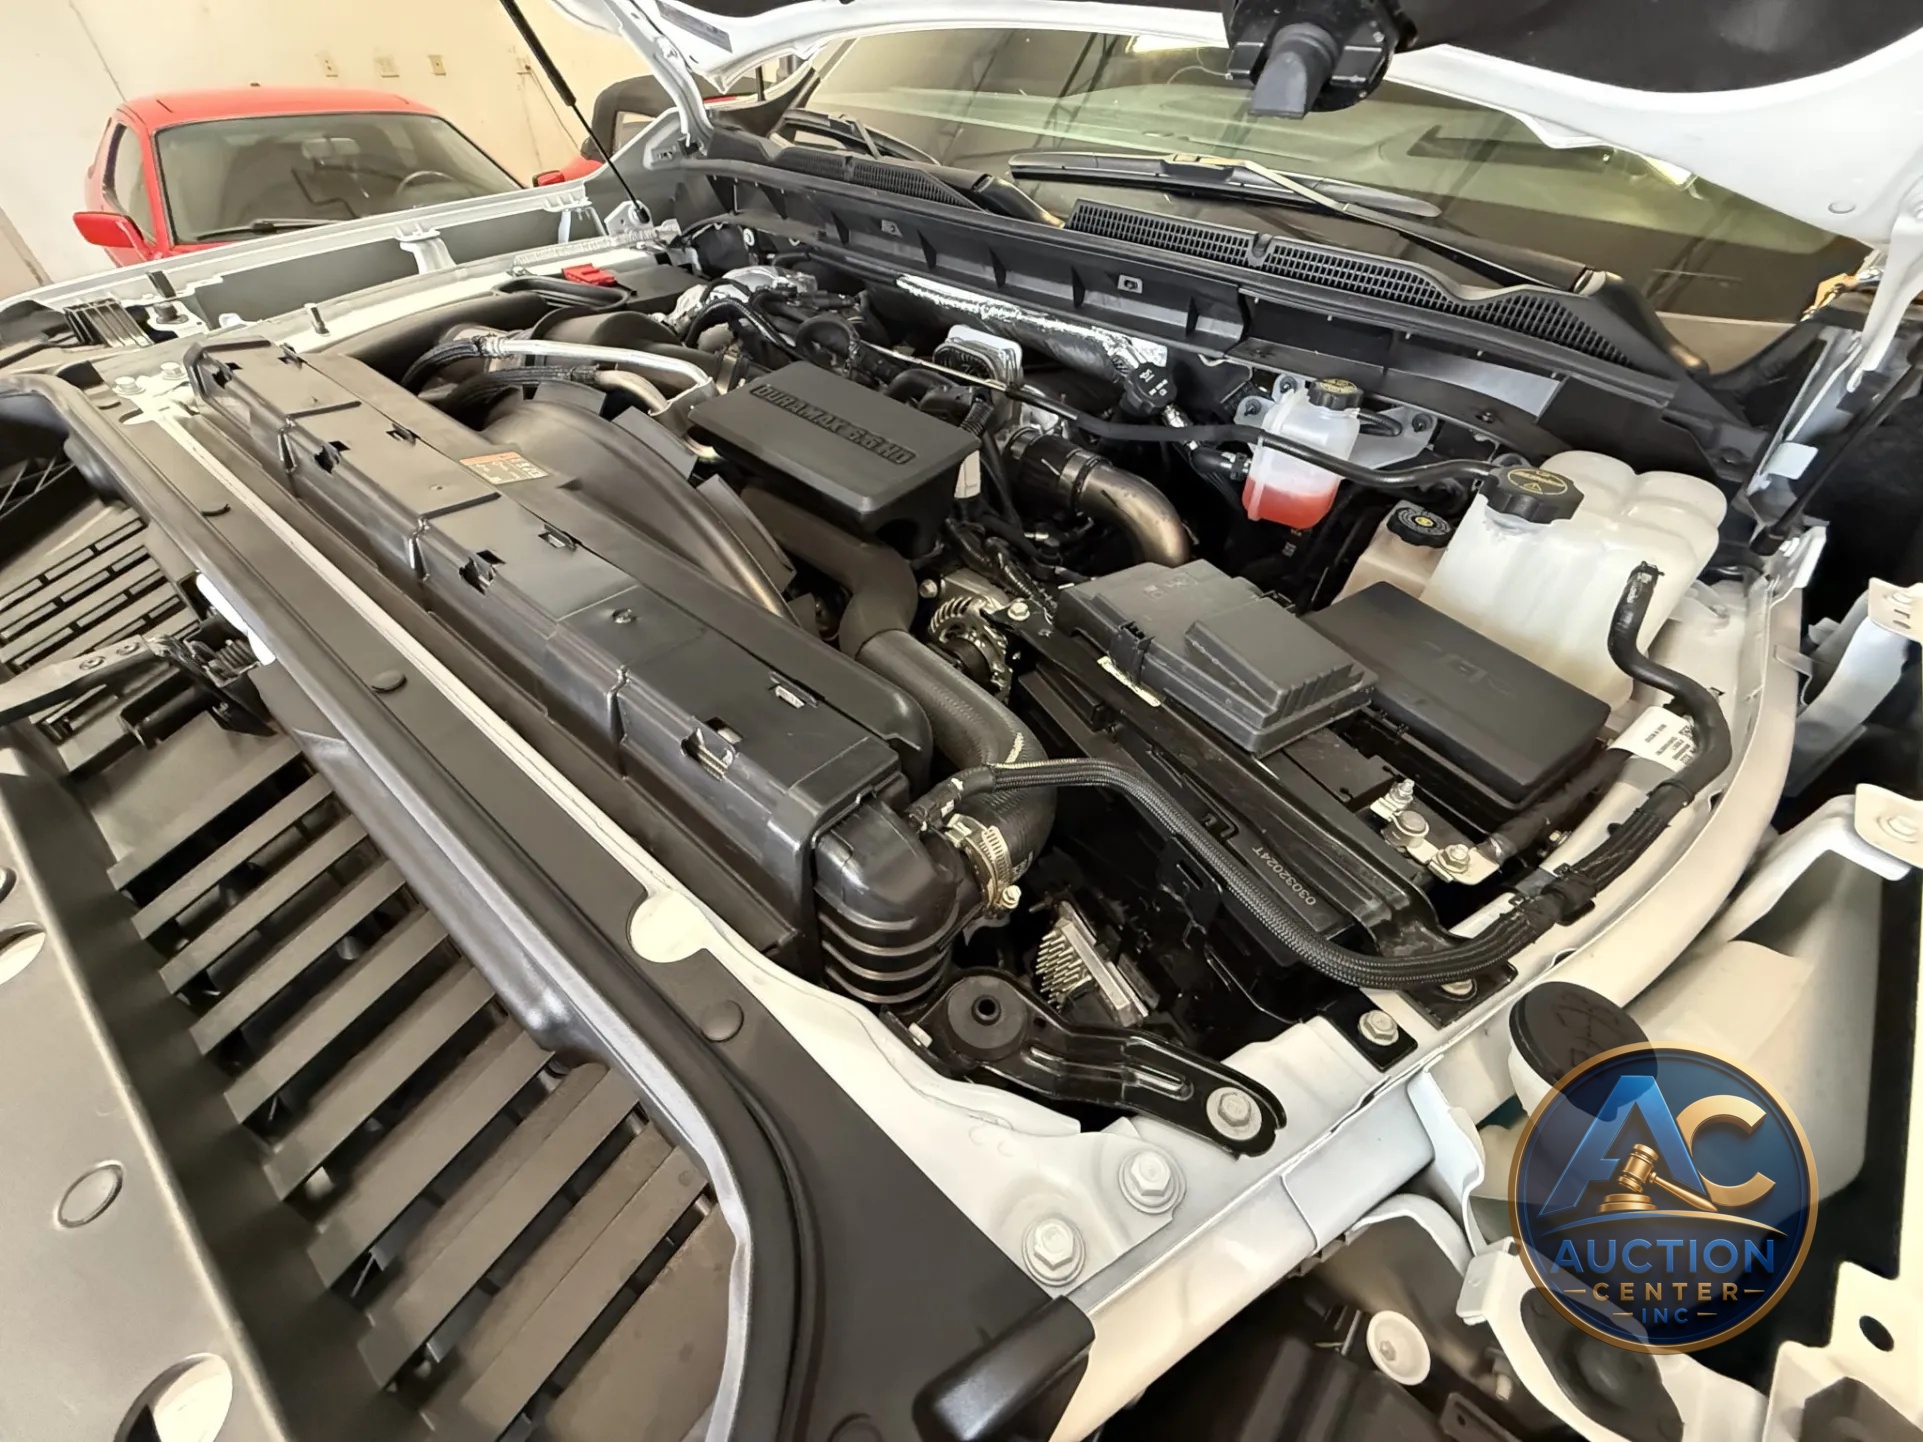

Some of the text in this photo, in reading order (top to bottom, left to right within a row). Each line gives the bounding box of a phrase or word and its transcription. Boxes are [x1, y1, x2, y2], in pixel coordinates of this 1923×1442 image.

[751, 385, 917, 464] DURAMAX 6.6 HD
[1252, 847, 1317, 905] 03032024T
